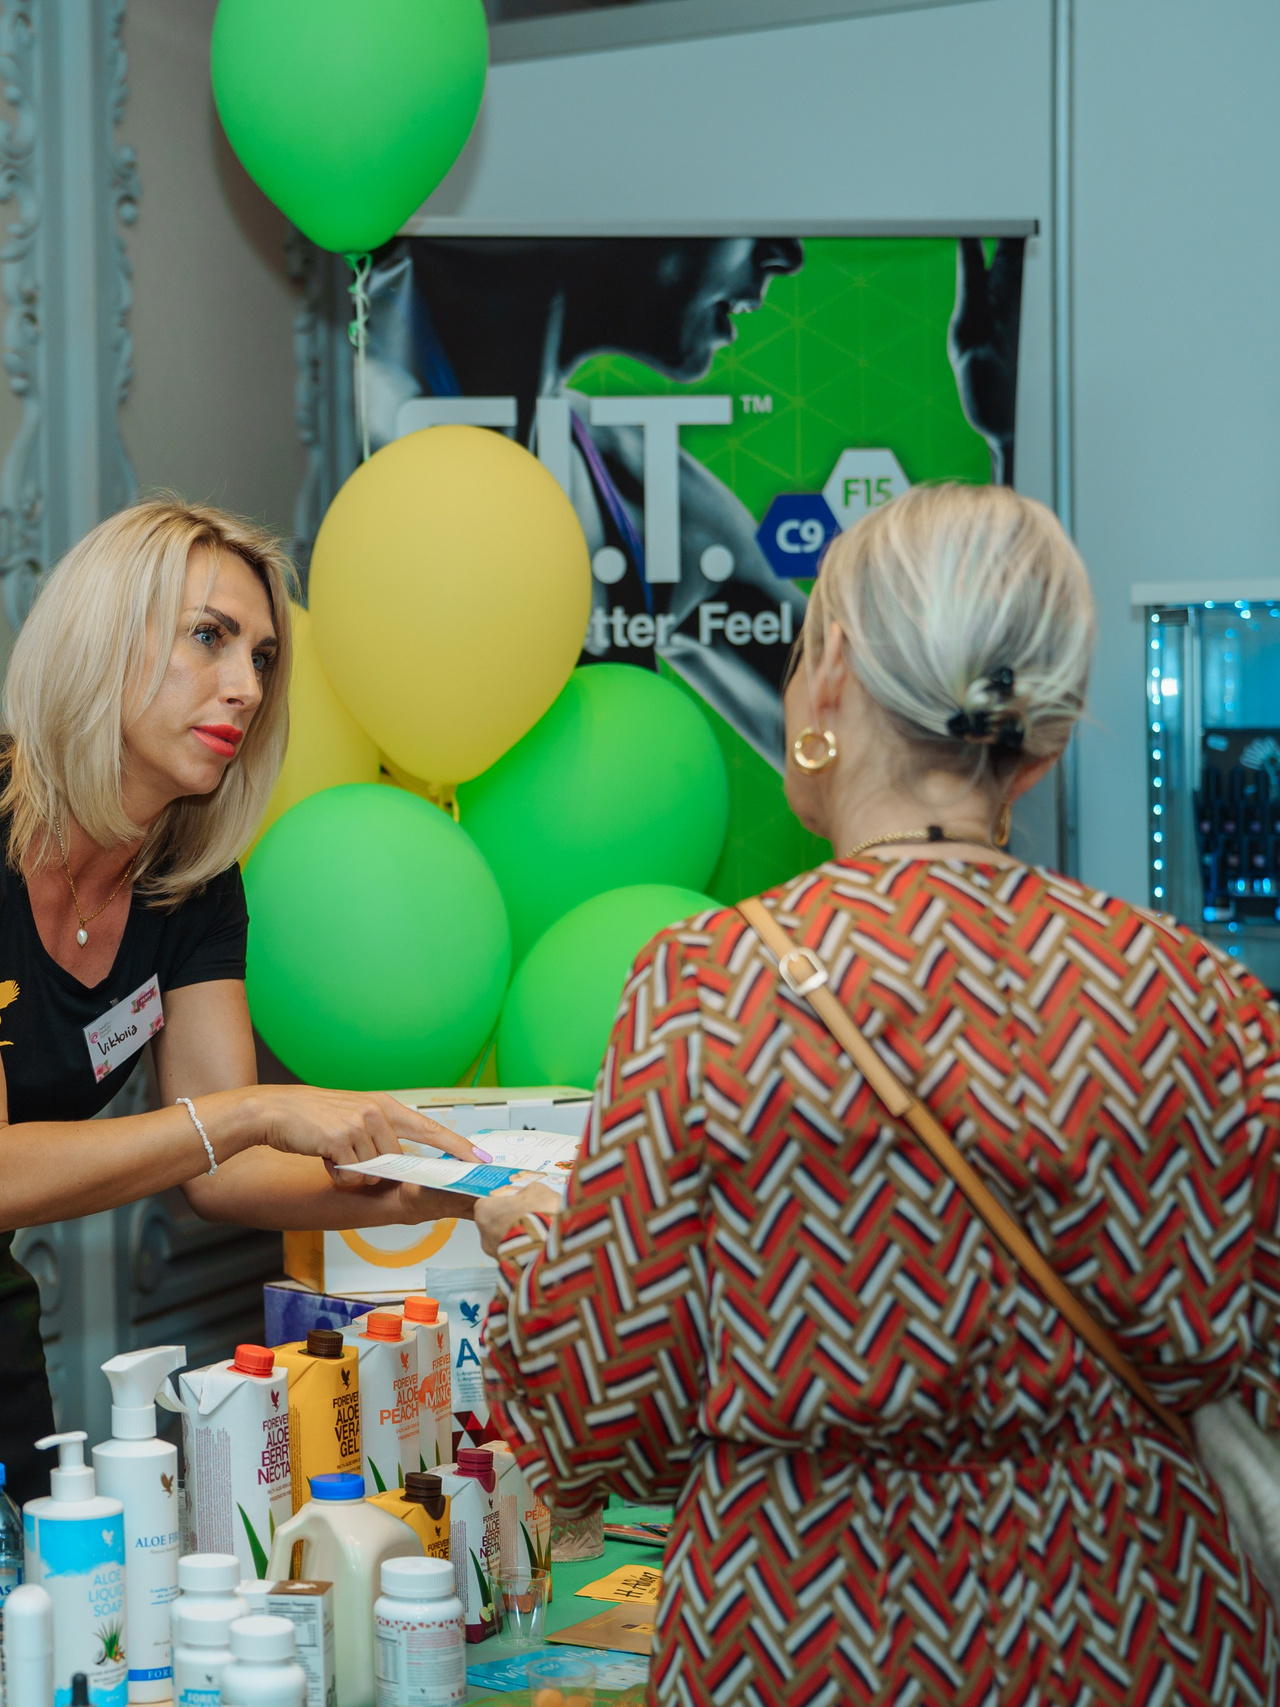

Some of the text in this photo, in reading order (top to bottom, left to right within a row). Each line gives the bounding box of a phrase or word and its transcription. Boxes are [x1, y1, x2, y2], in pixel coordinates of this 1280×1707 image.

[842, 477, 894, 508] F15
[775, 518, 824, 555] C9
[585, 601, 794, 649] tter. Feel
[432, 1353, 451, 1370] FOREVE
[332, 1391, 359, 1409] FOREVE
[396, 1385, 419, 1408] ALOE
[425, 1385, 451, 1407] MANG
[262, 1413, 289, 1432] FOREVE
[336, 1403, 359, 1426] ALOE
[379, 1401, 419, 1426] PEACH
[267, 1426, 290, 1449] ALOE
[340, 1437, 360, 1458] GEL
[261, 1443, 290, 1467] BERR
[257, 1460, 291, 1485] NECTA
[135, 1535, 167, 1549] ALOE
[480, 1542, 501, 1559] NECTA
[93, 1568, 122, 1587] ALOE
[93, 1598, 124, 1618] SOAP
